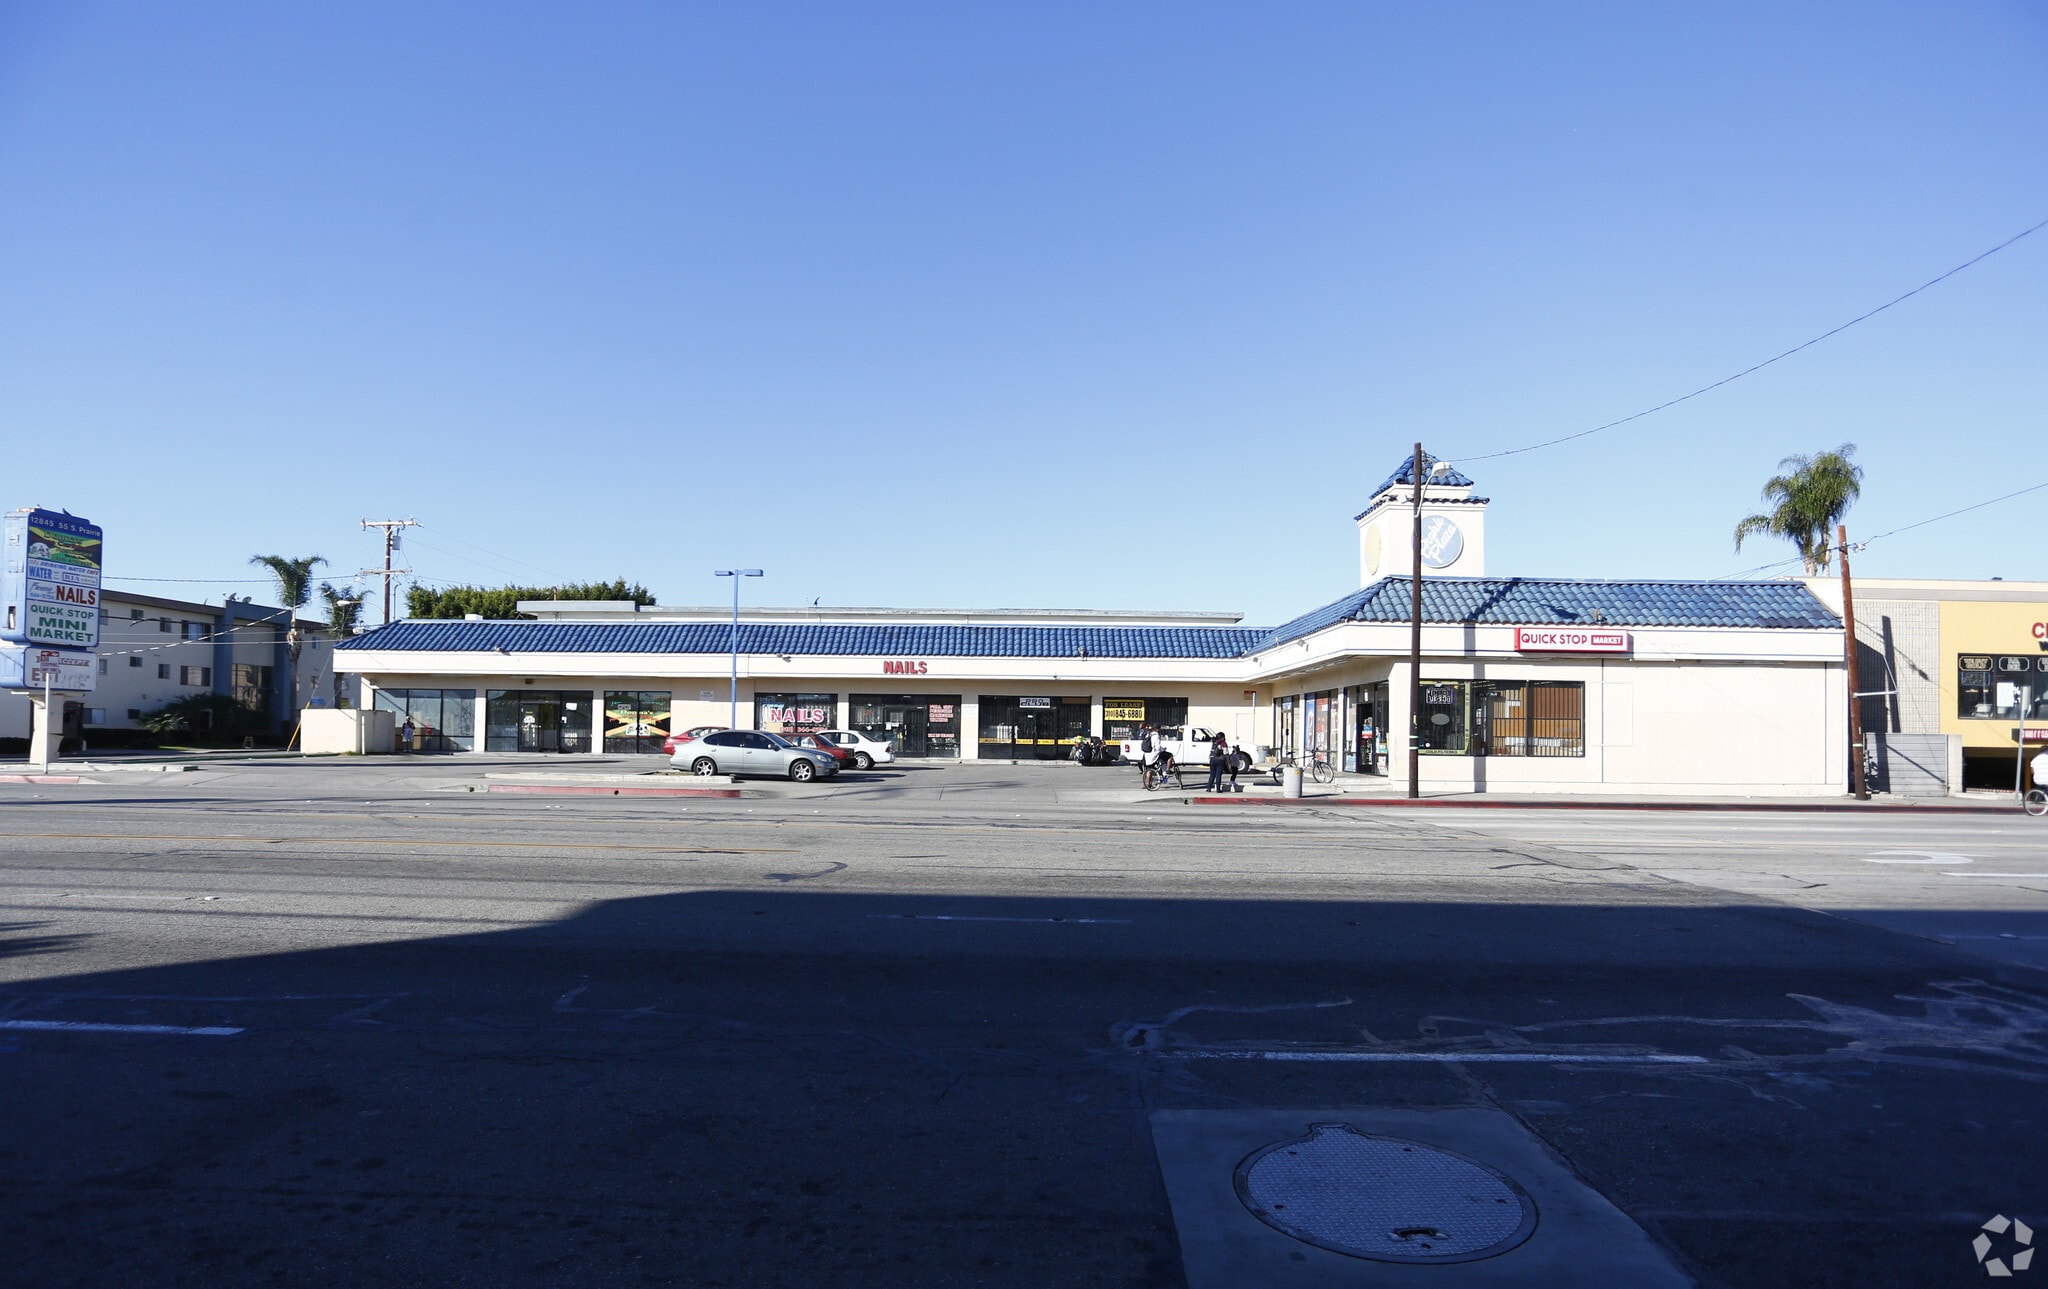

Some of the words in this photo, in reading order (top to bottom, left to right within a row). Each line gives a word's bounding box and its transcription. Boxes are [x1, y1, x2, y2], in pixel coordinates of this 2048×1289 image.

[30, 516, 54, 527] 12845
[29, 565, 52, 580] WATER
[56, 585, 96, 605] NAILS
[30, 604, 63, 616] QUICK
[67, 609, 94, 620] STOP
[38, 616, 87, 631] MINI
[30, 627, 94, 642] MARKET
[1521, 633, 1557, 645] QUICK
[1559, 634, 1588, 645] STOP
[1592, 636, 1622, 644] MARKET
[883, 661, 928, 674] NAILS
[770, 708, 824, 723] NAILS
